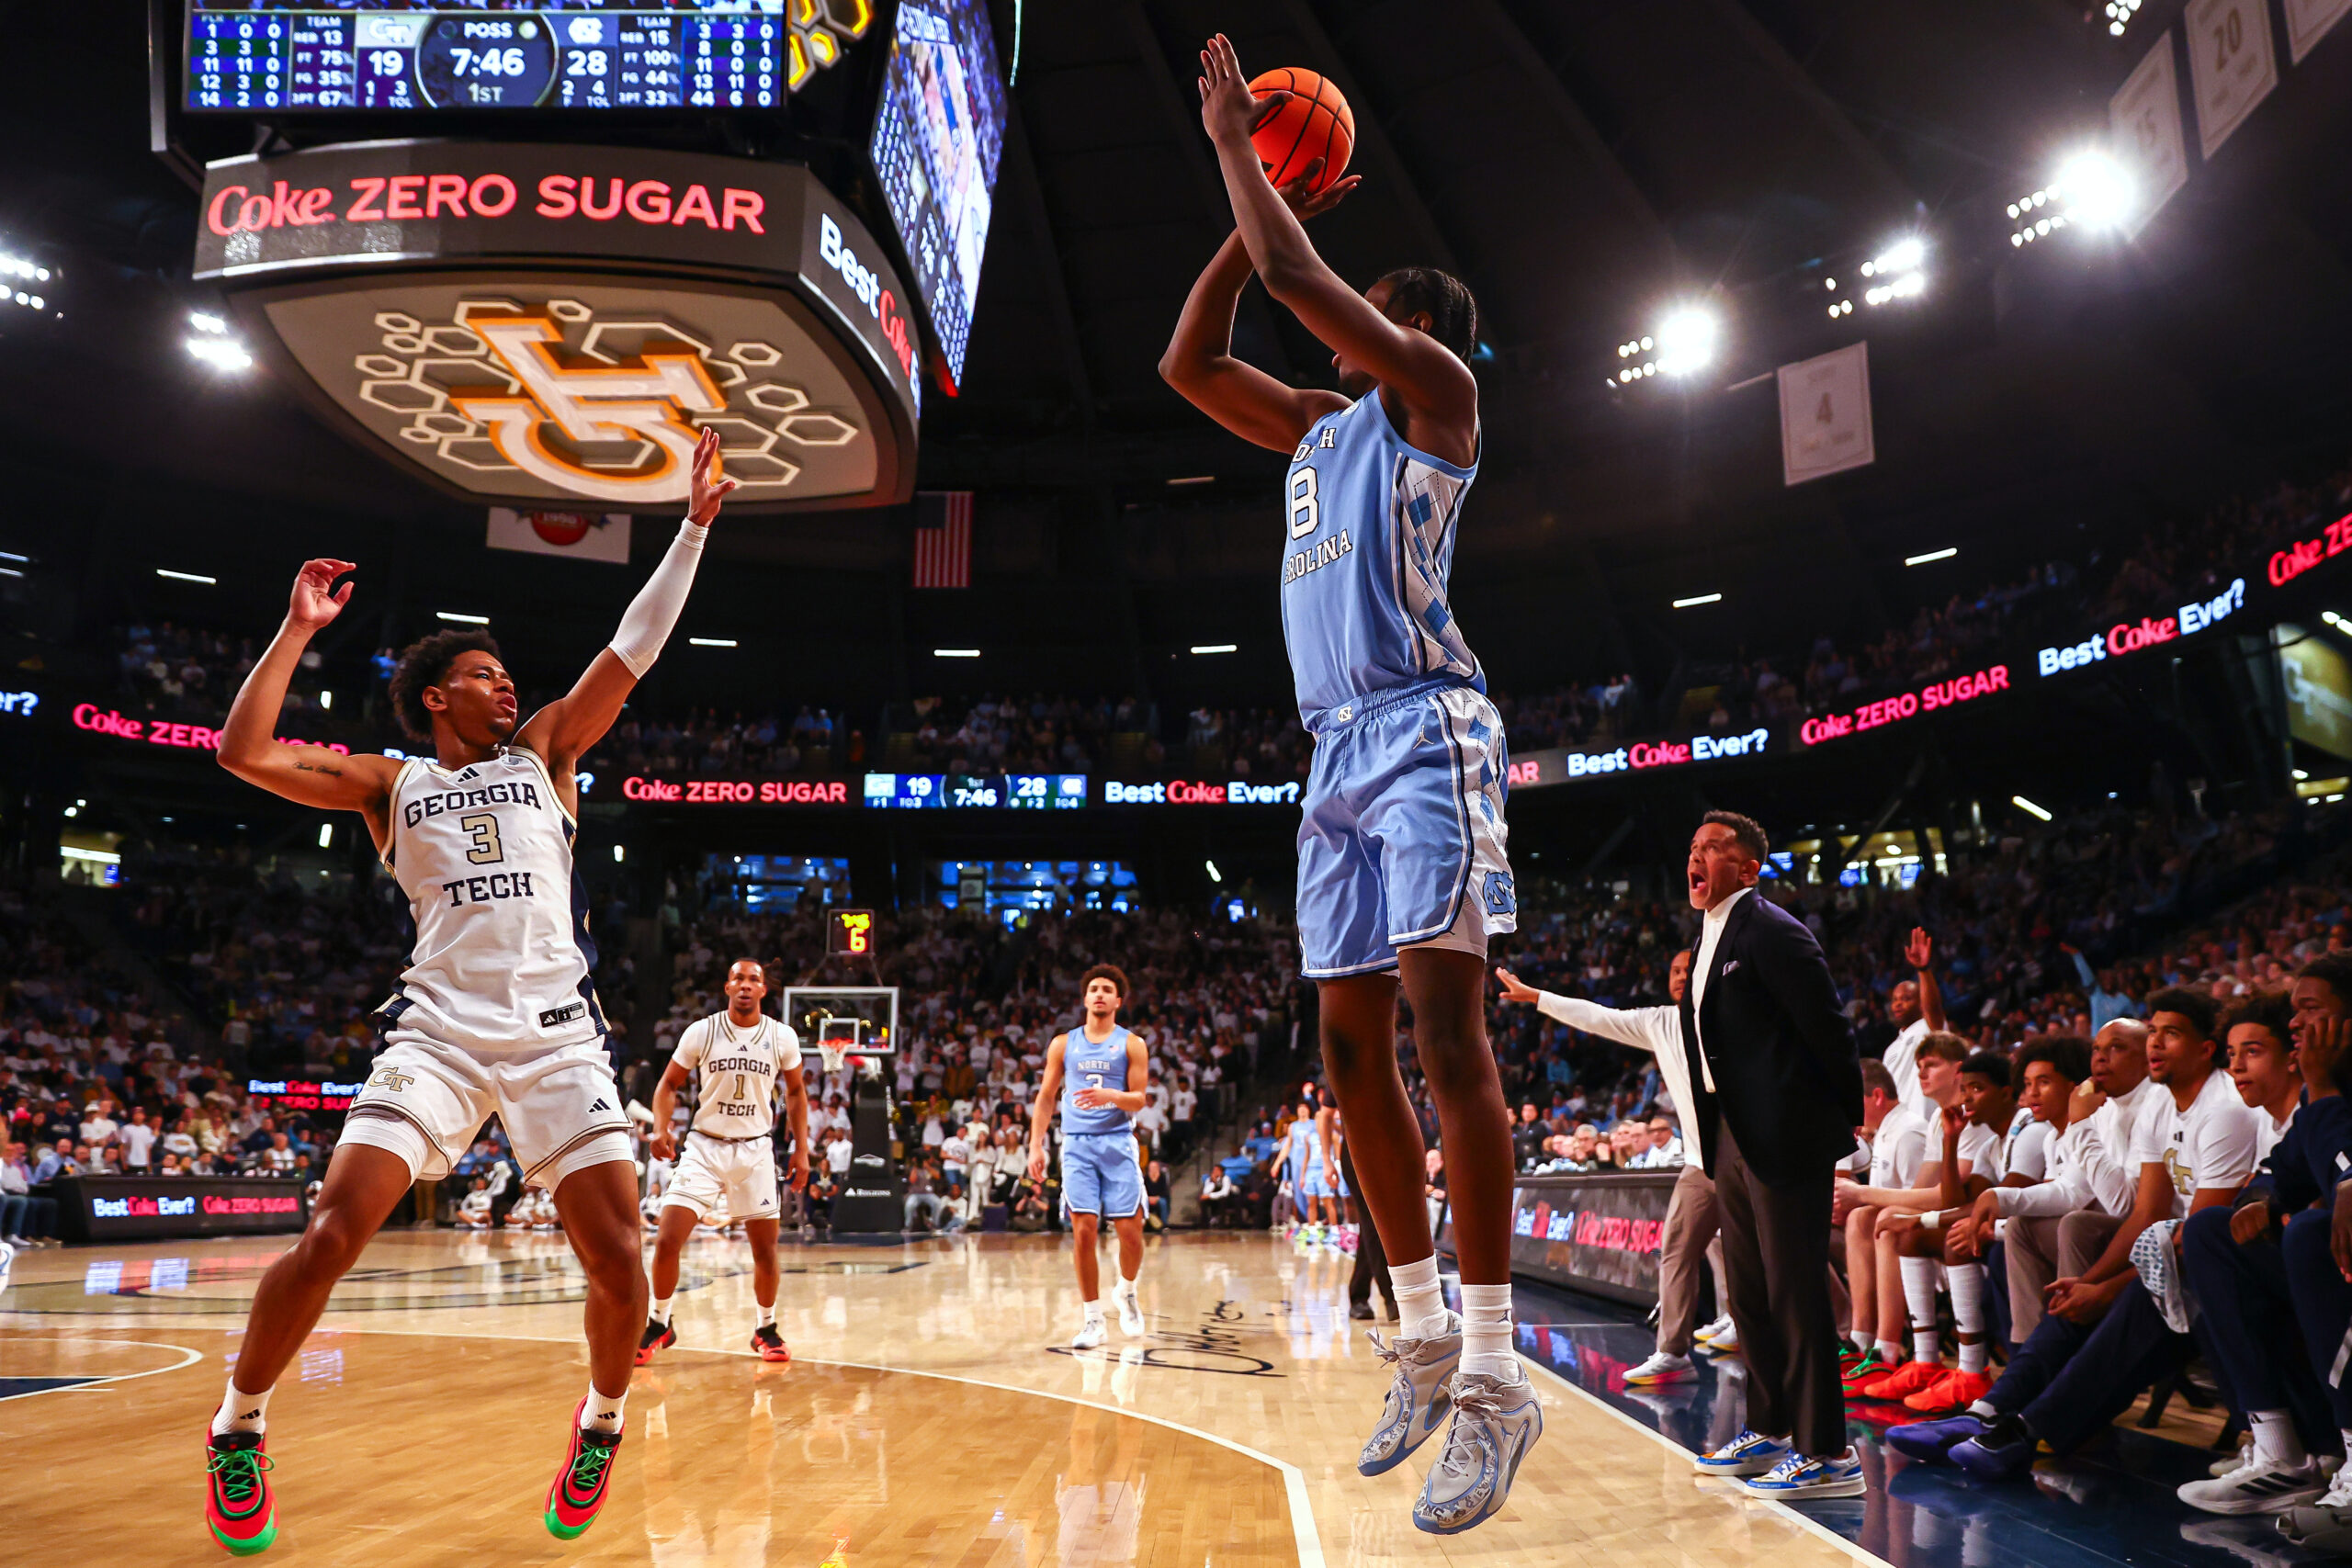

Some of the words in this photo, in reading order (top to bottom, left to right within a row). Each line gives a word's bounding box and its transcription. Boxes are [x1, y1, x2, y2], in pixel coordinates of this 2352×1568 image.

[207, 23, 217, 39] 1
[239, 23, 254, 39] 0
[267, 23, 281, 39] 0
[307, 16, 343, 28] TEAM
[464, 22, 513, 39] POSS
[636, 16, 672, 28] TEAM
[698, 23, 712, 39] 3
[731, 23, 745, 39] 3
[759, 23, 774, 39] 0
[206, 39, 219, 55] 3
[239, 39, 252, 55] 3
[268, 39, 278, 56] 1
[322, 29, 343, 46] 13
[649, 29, 670, 46] 15
[698, 39, 712, 56] 8
[730, 39, 745, 56] 0
[761, 39, 771, 56] 1
[202, 57, 220, 73] 11
[236, 57, 254, 73] 11
[266, 57, 280, 73] 0
[368, 50, 404, 77] 19
[449, 48, 526, 77] 7:46
[566, 50, 608, 77] 28
[695, 57, 713, 73] 11
[729, 56, 745, 73] 0
[758, 56, 774, 73] 0
[200, 74, 221, 90] 12
[237, 74, 251, 90] 3
[265, 74, 280, 90] 0
[365, 80, 375, 96] 1
[394, 80, 408, 96] 3
[561, 79, 575, 96] 2
[592, 79, 606, 96] 4
[693, 73, 714, 90] 13
[727, 73, 745, 90] 11
[758, 73, 772, 90] 0
[198, 91, 221, 107] 14
[235, 91, 251, 107] 2
[264, 91, 279, 107] 0
[468, 82, 503, 104] 1ST
[690, 90, 715, 107] 44
[729, 90, 743, 107] 6
[757, 90, 772, 107] 0
[207, 181, 335, 237] Coke
[346, 174, 517, 223] ZERO
[536, 175, 765, 235] SUGAR
[820, 213, 880, 319] Best
[879, 289, 912, 378] Coke
[1289, 465, 1319, 541] 8
[1284, 528, 1353, 585] ROLINA
[2267, 538, 2324, 587] Coke
[2038, 633, 2107, 677] Best
[2107, 617, 2181, 656] Coke
[2178, 578, 2245, 636] Ever?
[1801, 714, 1855, 746] Coke
[1855, 692, 1919, 732] ZERO
[1922, 664, 2011, 711] SUGAR
[73, 703, 143, 739] Coke
[1567, 747, 1629, 777] Best
[1628, 740, 1692, 769] Coke
[1691, 728, 1770, 761] Ever?
[623, 776, 683, 802] Coke
[686, 782, 754, 802] ZERO
[760, 782, 847, 803] SUGAR
[906, 776, 933, 796] 19
[1016, 776, 1046, 796] 28
[1105, 782, 1166, 804] Best
[1166, 780, 1227, 804] Coke
[1227, 782, 1300, 804] Ever?
[404, 782, 542, 829] GEORGIA
[954, 788, 998, 807] 7:46
[461, 813, 503, 864] 3
[443, 873, 534, 908] TECH
[850, 927, 865, 952] 6
[708, 1057, 771, 1076] GEORGIA
[1078, 1060, 1110, 1071] NORTH
[248, 1079, 287, 1093] Best
[733, 1074, 745, 1100] 1
[718, 1101, 756, 1116] TECH
[93, 1198, 130, 1217] Best
[128, 1196, 159, 1216] Coke
[157, 1196, 196, 1215] Ever?
[1628, 1219, 1665, 1254] SUGA
